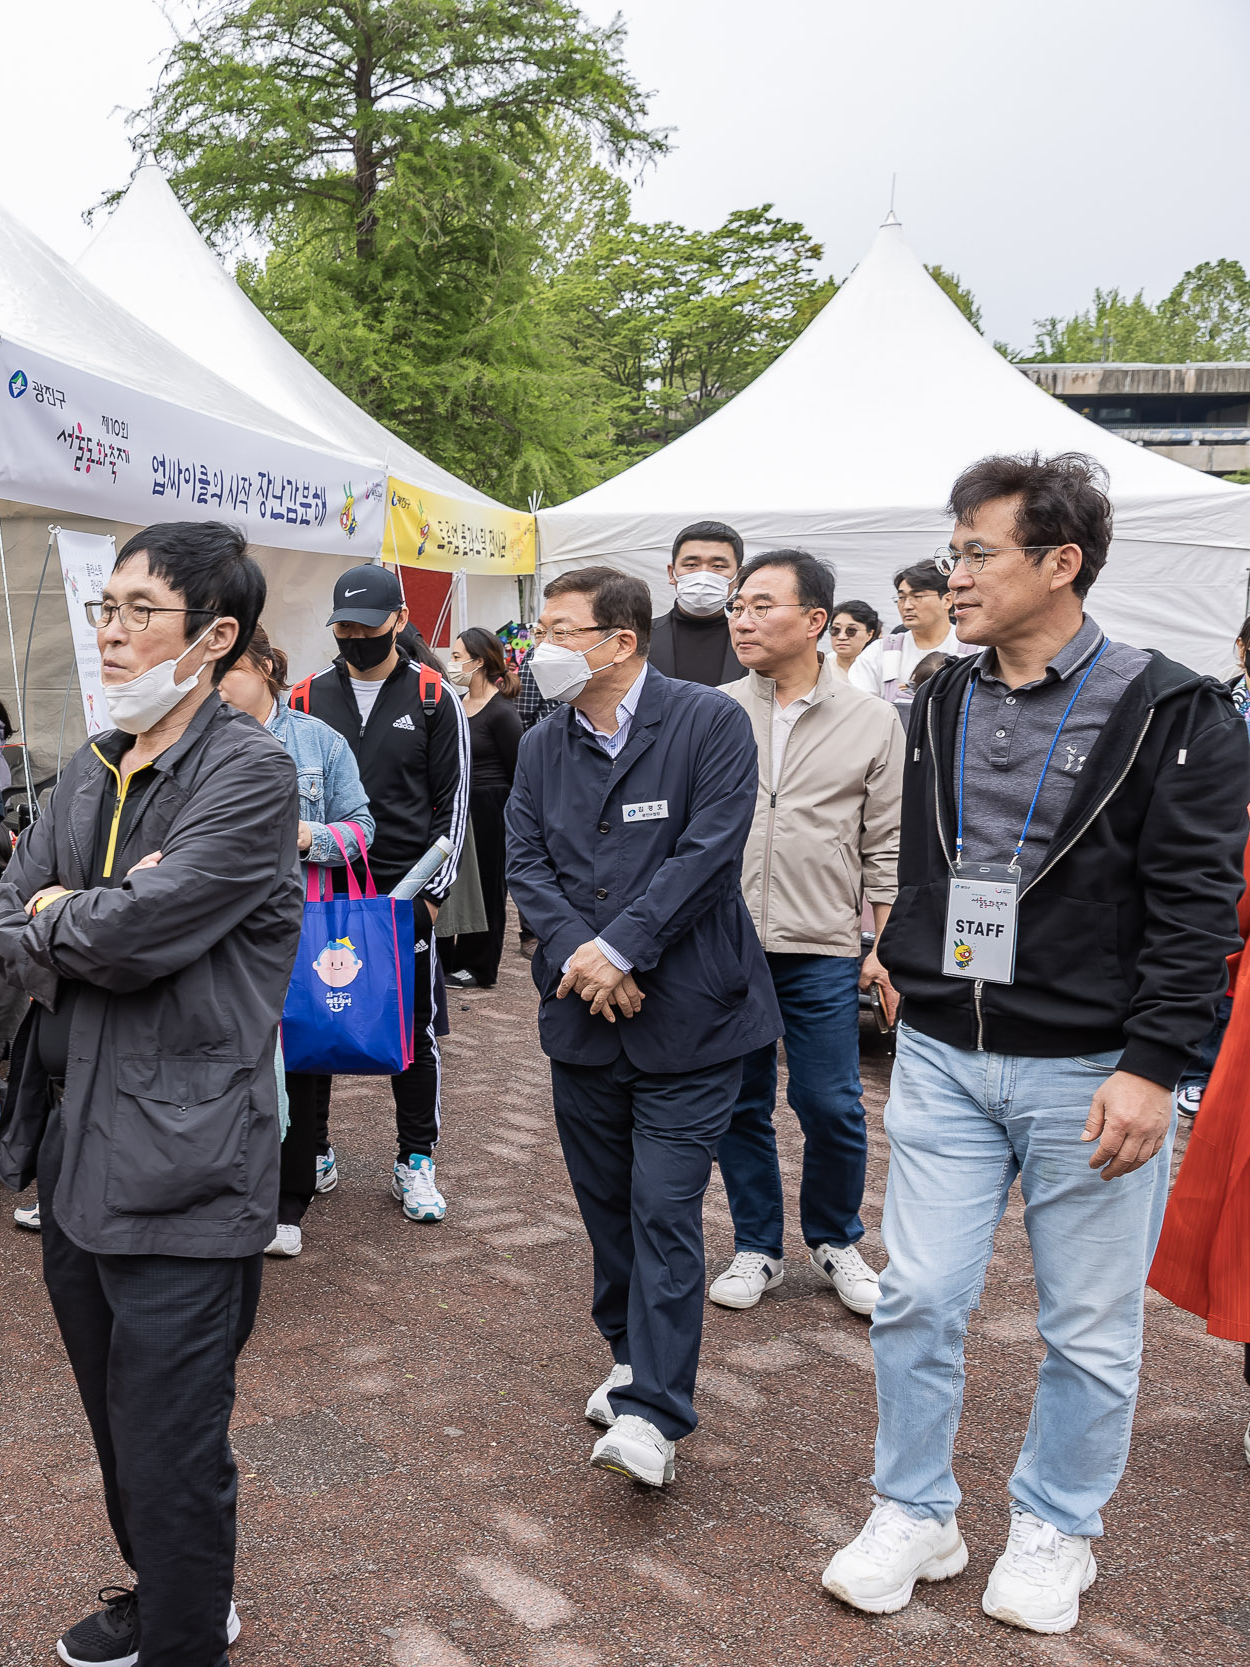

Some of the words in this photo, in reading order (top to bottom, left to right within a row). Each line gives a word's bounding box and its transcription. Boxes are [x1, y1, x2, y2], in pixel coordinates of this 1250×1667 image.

[32, 380, 67, 409] 광진구
[101, 415, 129, 440] 제10회
[56, 421, 130, 485] 서울동화축제
[152, 453, 225, 508] 업싸이클의
[225, 472, 253, 515] 시작
[393, 721, 415, 731] adidas
[955, 919, 1005, 938] STAFF
